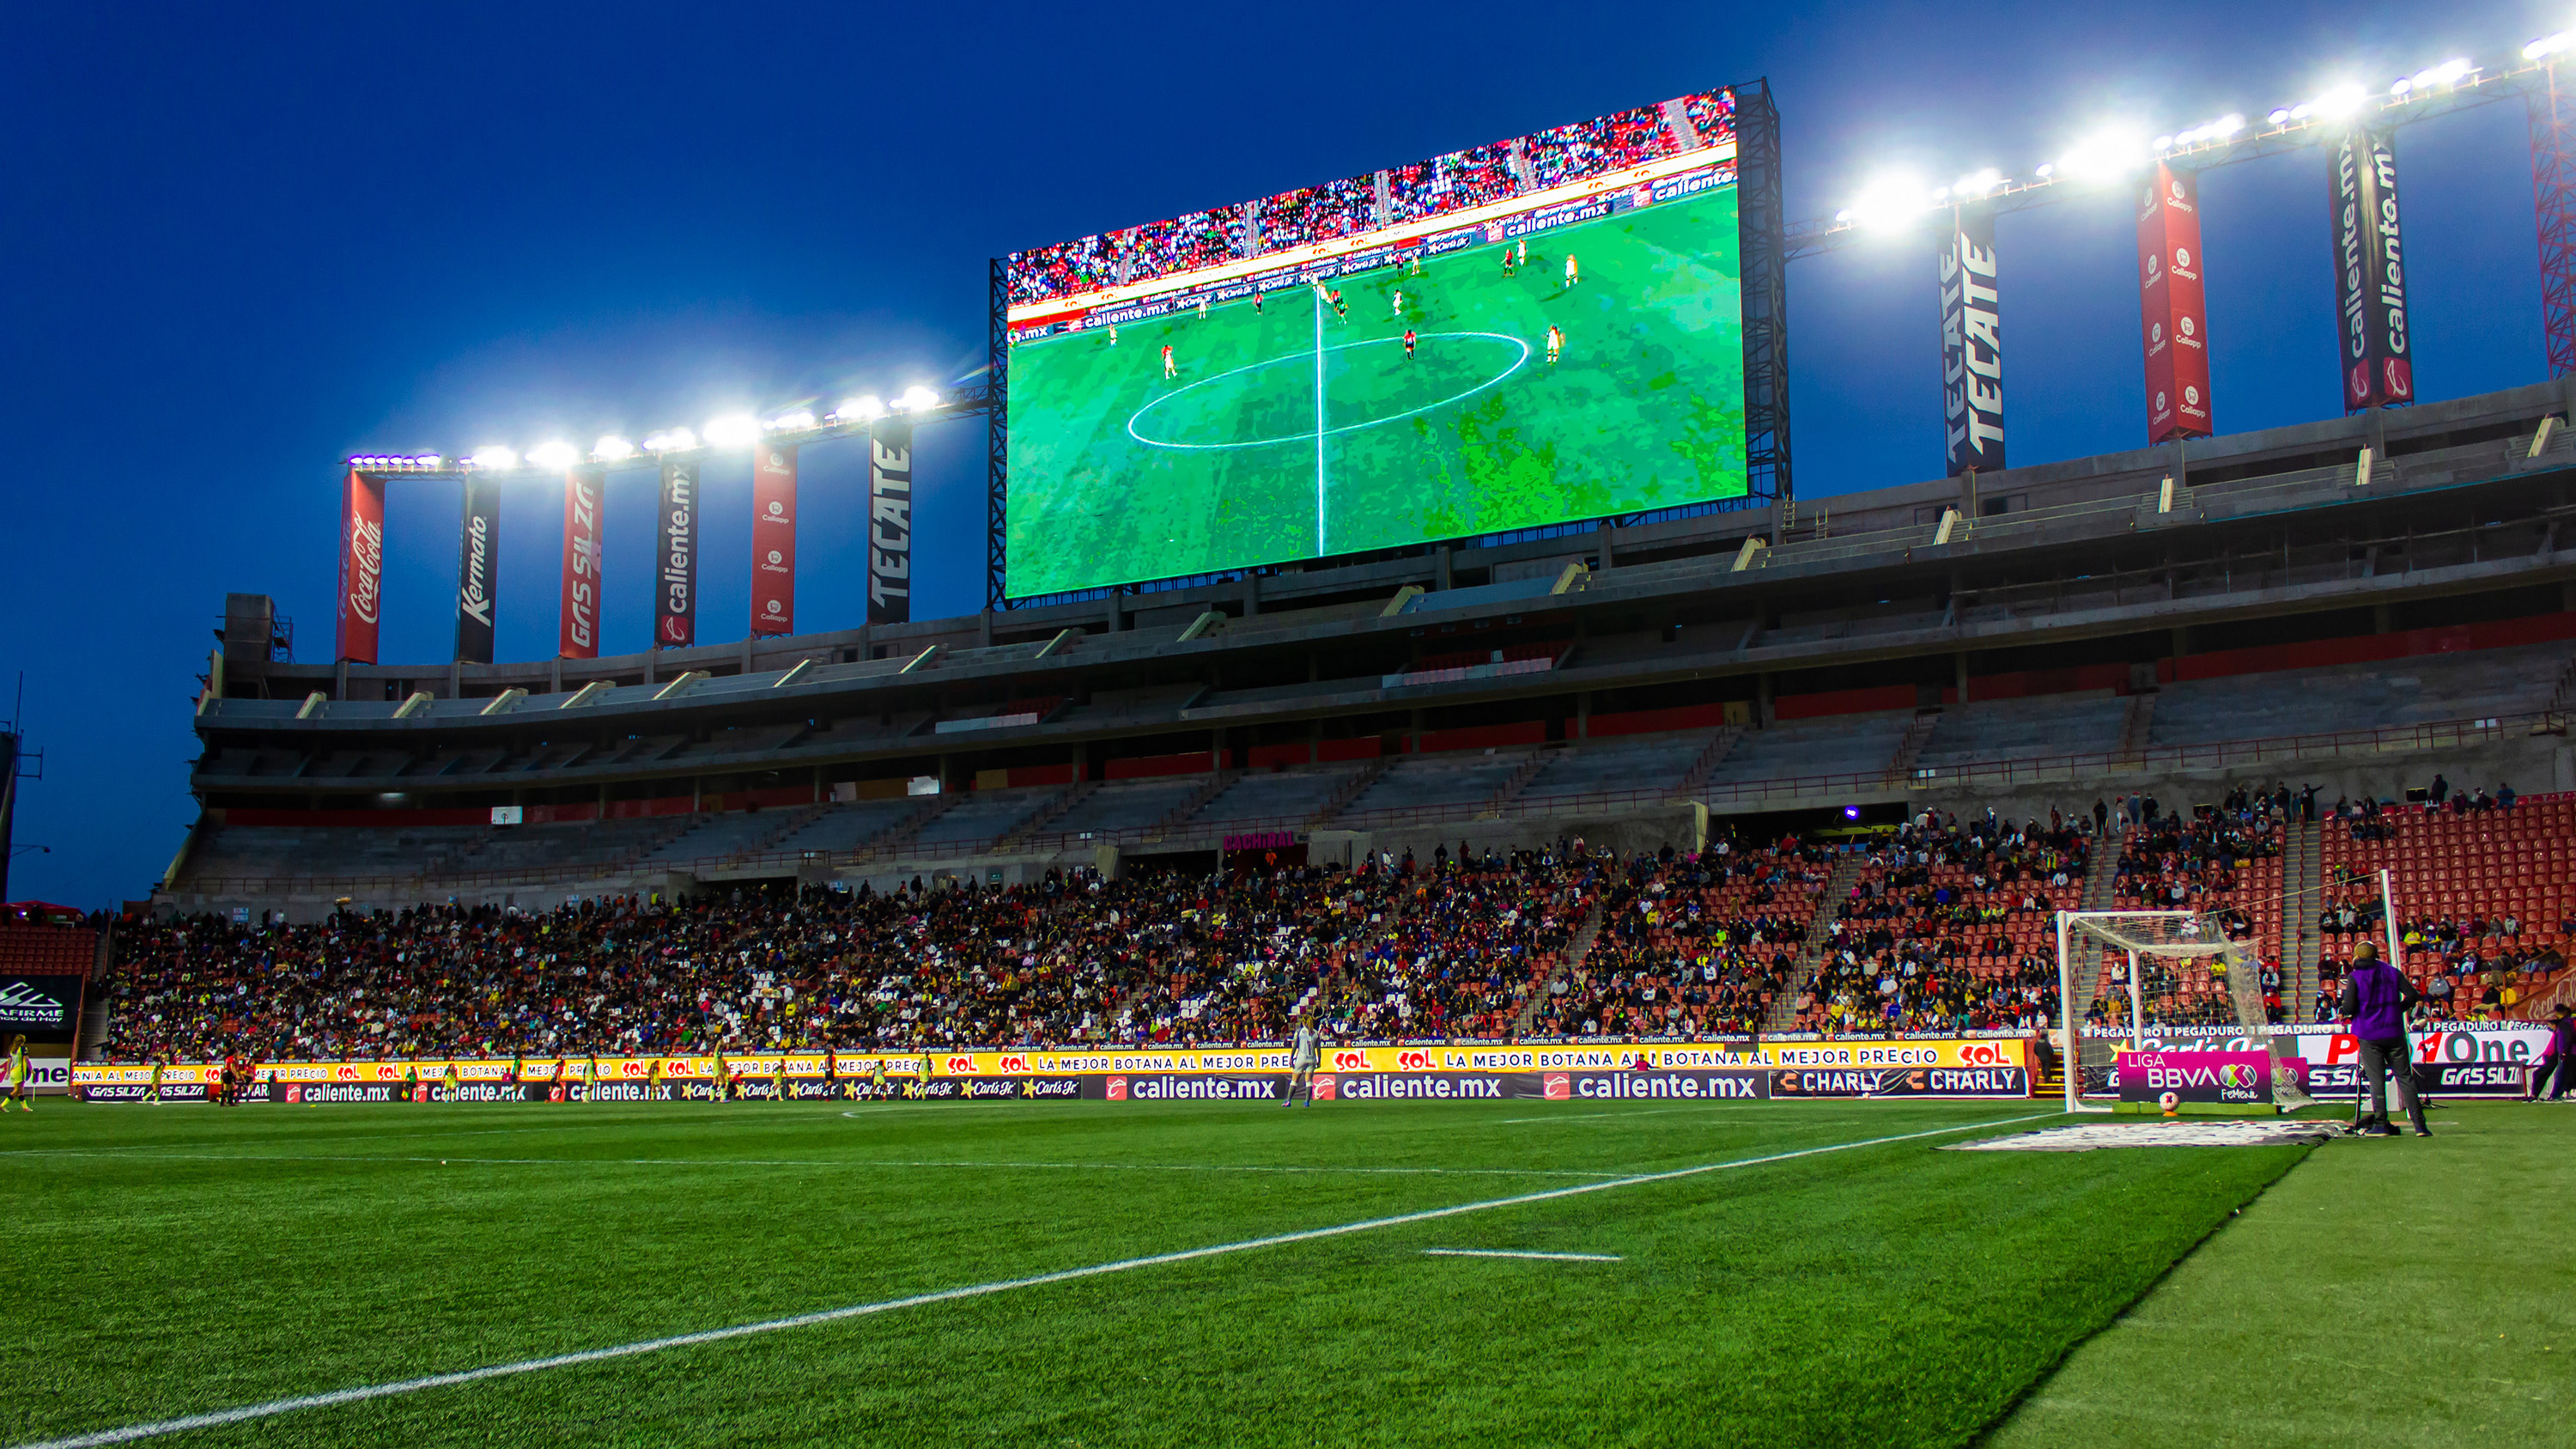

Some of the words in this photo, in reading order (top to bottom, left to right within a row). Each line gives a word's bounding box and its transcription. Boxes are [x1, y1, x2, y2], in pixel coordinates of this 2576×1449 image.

[1507, 204, 1607, 236] caliente.mx
[2338, 132, 2365, 359] caliente.mx
[1085, 303, 1170, 328] caliente.mx
[1939, 235, 1966, 464] TECATE
[1960, 232, 2004, 455] TECATE
[871, 438, 910, 608] TECATE
[665, 462, 691, 613] caliente.mx
[462, 515, 492, 628] Kermato
[2093, 1027, 2161, 1038] PEGADRO
[2174, 1026, 2245, 1037] PEGADURO
[2433, 1021, 2499, 1032] PEGADURO
[1577, 1036, 1623, 1044] caliente.mx
[1638, 1035, 1686, 1044] caliente.mx
[1702, 1034, 1750, 1043] caliente.mx
[1767, 1033, 1817, 1042] caliente.mx
[1835, 1032, 1886, 1041] caliente.mx
[1905, 1031, 1957, 1040] caliente.mx
[1977, 1030, 2032, 1038] caliente.mx
[1000, 1055, 1031, 1073] SOL
[1039, 1058, 1055, 1070] LA
[1060, 1058, 1109, 1070] MEJOR
[1115, 1057, 1172, 1069] BOTANA
[1179, 1057, 1197, 1068] AL
[1203, 1056, 1254, 1068] MEJOR
[1334, 1050, 1371, 1071] SOL
[1399, 1049, 1436, 1070] SOL
[1447, 1055, 1467, 1067] LA
[1474, 1055, 1532, 1067] MEJOR
[1540, 1054, 1613, 1066] BOTANA
[1664, 1052, 1741, 1065] BOTANA
[1750, 1052, 1771, 1064] AL
[1782, 1050, 1850, 1063] MEJOR
[1860, 1050, 1938, 1063] PRECIO
[1959, 1043, 2010, 1067] SOL
[2128, 1054, 2166, 1068] LIGA
[290, 1068, 328, 1079] PRECIO
[337, 1065, 361, 1081] SOL
[377, 1063, 401, 1081] SOL
[462, 1067, 505, 1077] BOTANA
[528, 1066, 564, 1075] MEJO
[623, 1061, 647, 1078] SOL
[667, 1059, 694, 1077] SOL
[730, 1062, 759, 1073] EJOR
[764, 1061, 813, 1072] BOANA
[948, 1056, 978, 1073] SOL
[107, 1071, 121, 1081] AL
[125, 1071, 150, 1081] MEJO
[205, 1068, 221, 1082] SO
[1803, 1071, 1883, 1092] CHARLY
[2148, 1066, 2219, 1088] BBVA
[305, 1083, 391, 1102] caliente.mx
[799, 1082, 823, 1096] Carl's
[974, 1081, 1000, 1095] Carl's
[1036, 1080, 1062, 1094] Carl's
[1133, 1076, 1276, 1099] caliente.mx
[1343, 1075, 1502, 1099] caliente.mx
[1578, 1073, 1757, 1098] caliente.mx
